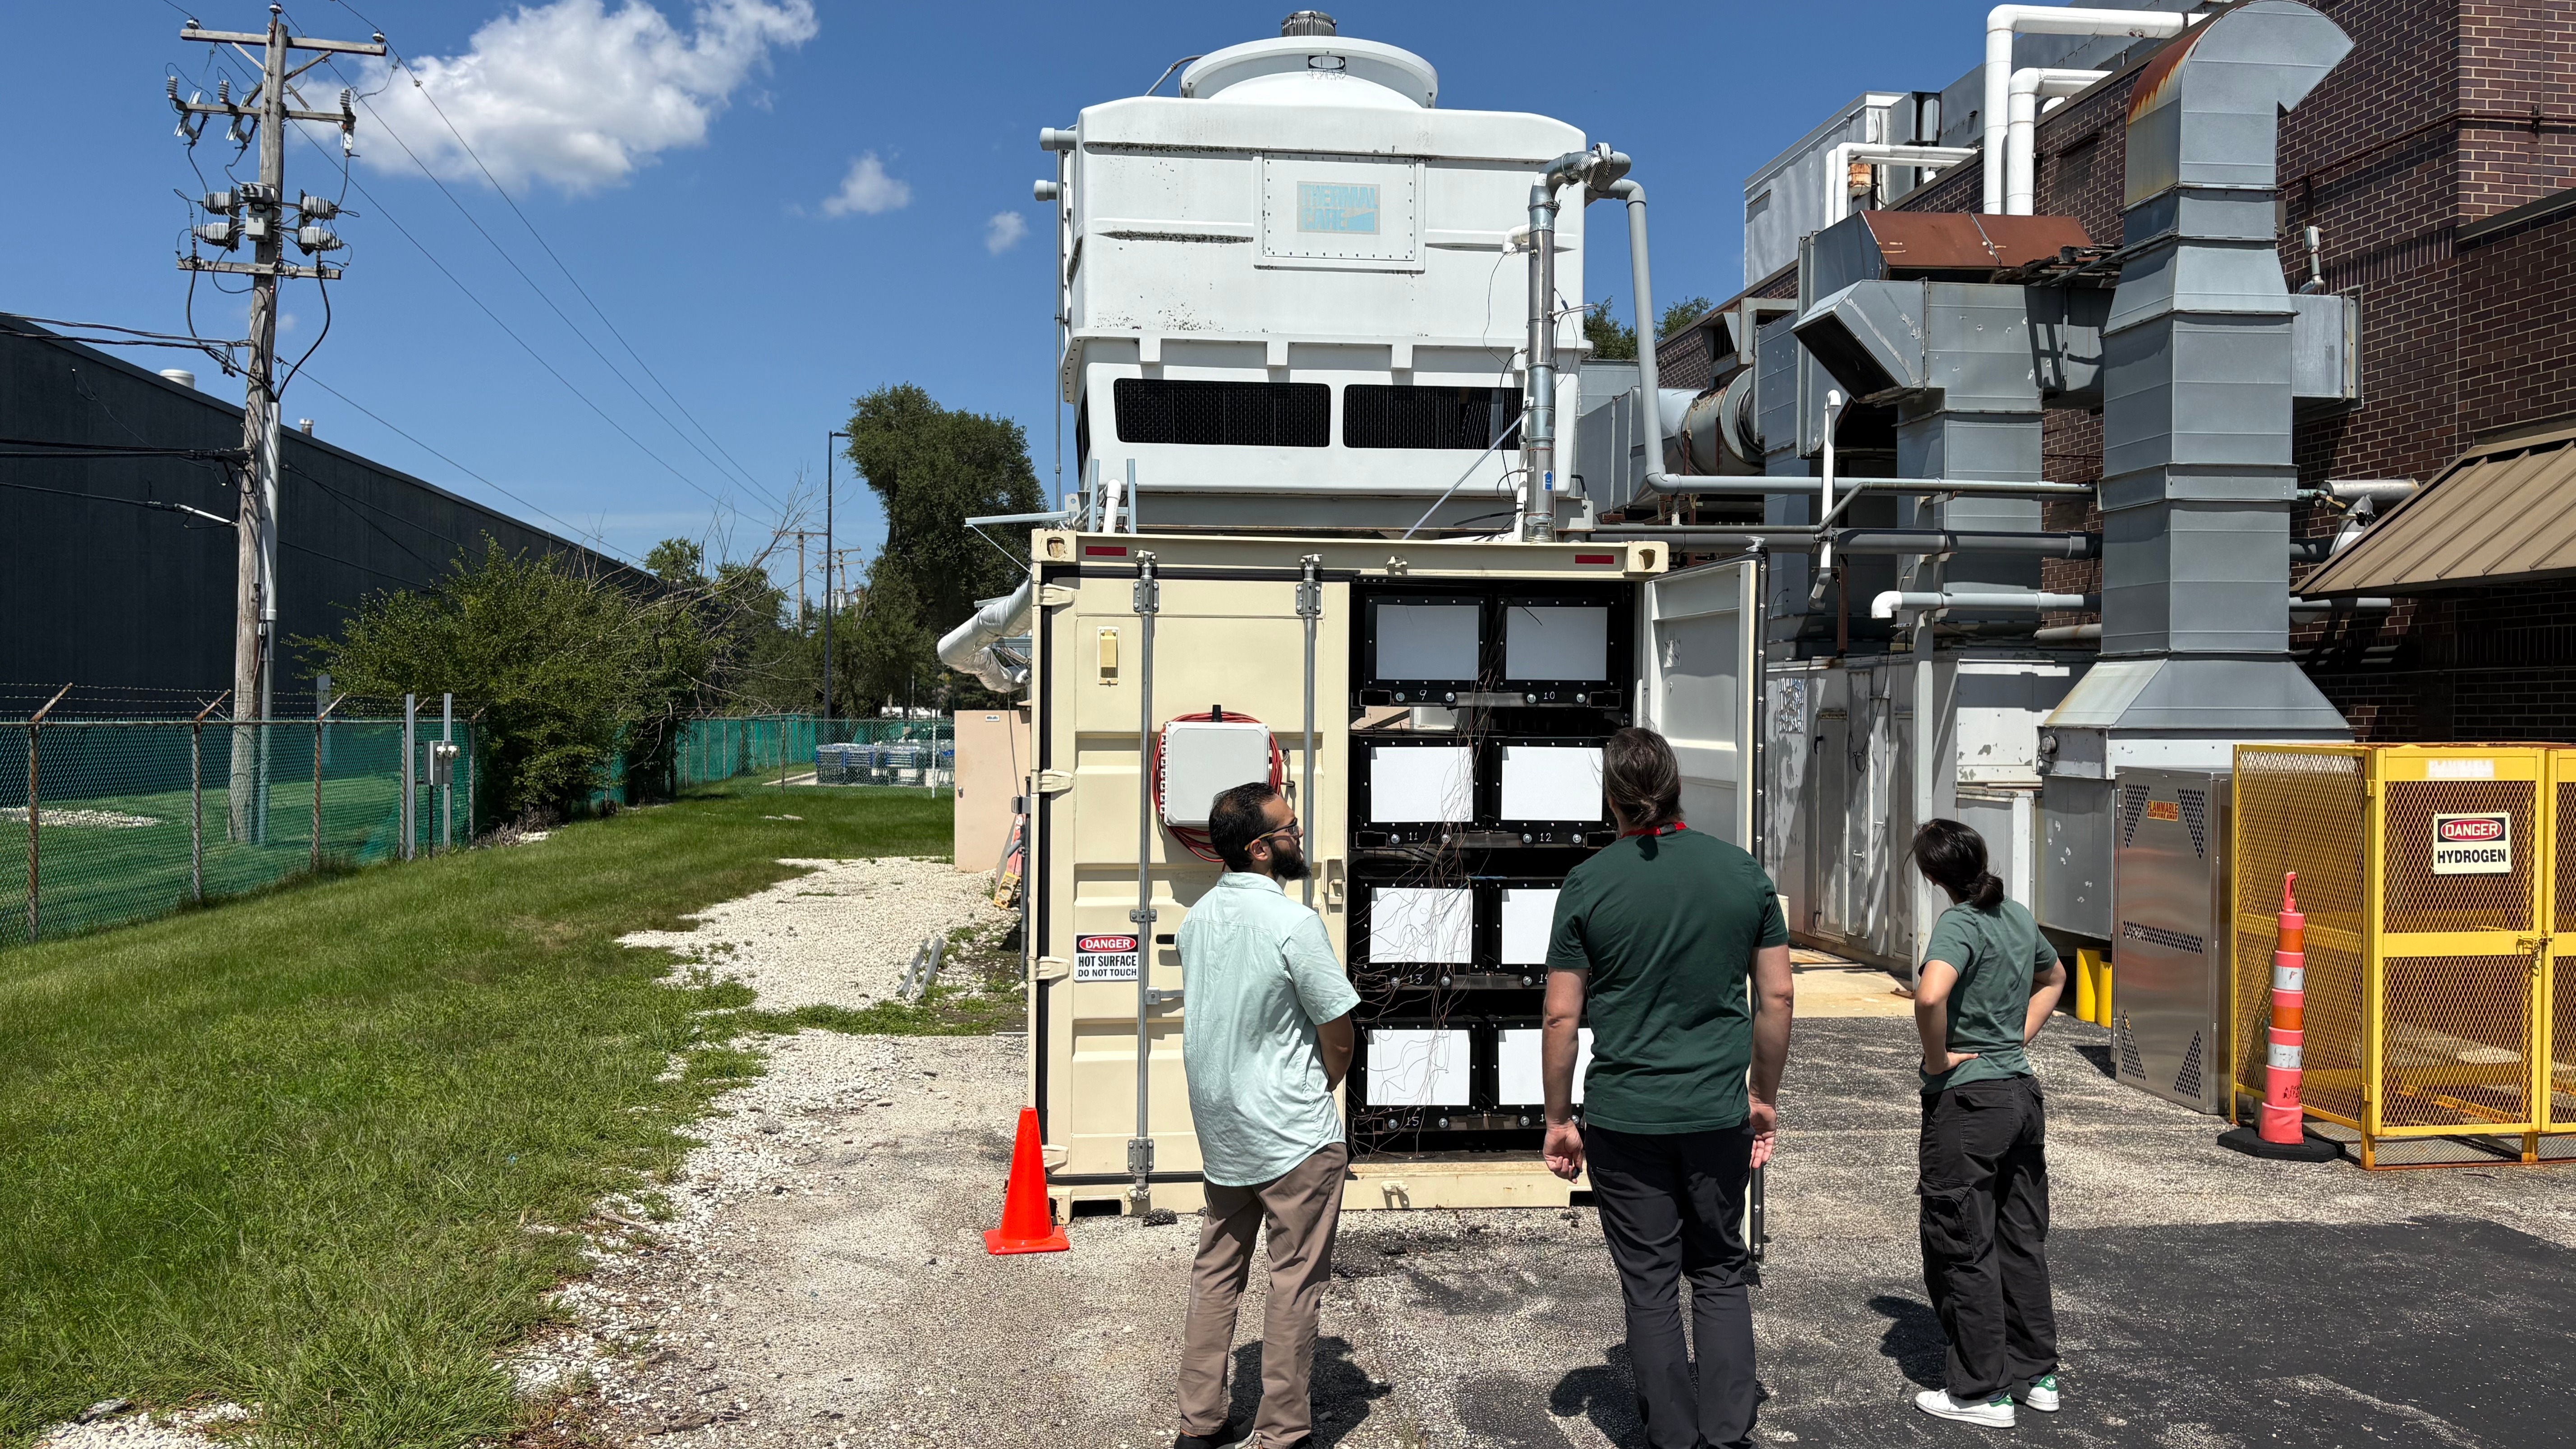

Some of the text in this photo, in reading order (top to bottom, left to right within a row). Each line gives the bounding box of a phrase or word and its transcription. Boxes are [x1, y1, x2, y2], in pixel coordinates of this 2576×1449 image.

[1299, 185, 1379, 209] THERMAL
[1302, 207, 1346, 231] CARE
[1419, 690, 1427, 700] 9
[1543, 691, 1555, 699] 10
[2148, 800, 2178, 814] FLAMMABLE
[2445, 823, 2498, 837] DANGER
[1409, 832, 1418, 841] 11
[1540, 833, 1552, 842] 12
[2438, 849, 2506, 864] HYDROGEN
[1086, 939, 1131, 949] DANGER
[1078, 955, 1137, 967] HOT SURFACE
[1409, 974, 1422, 984] 13
[1407, 1116, 1419, 1126] 15
